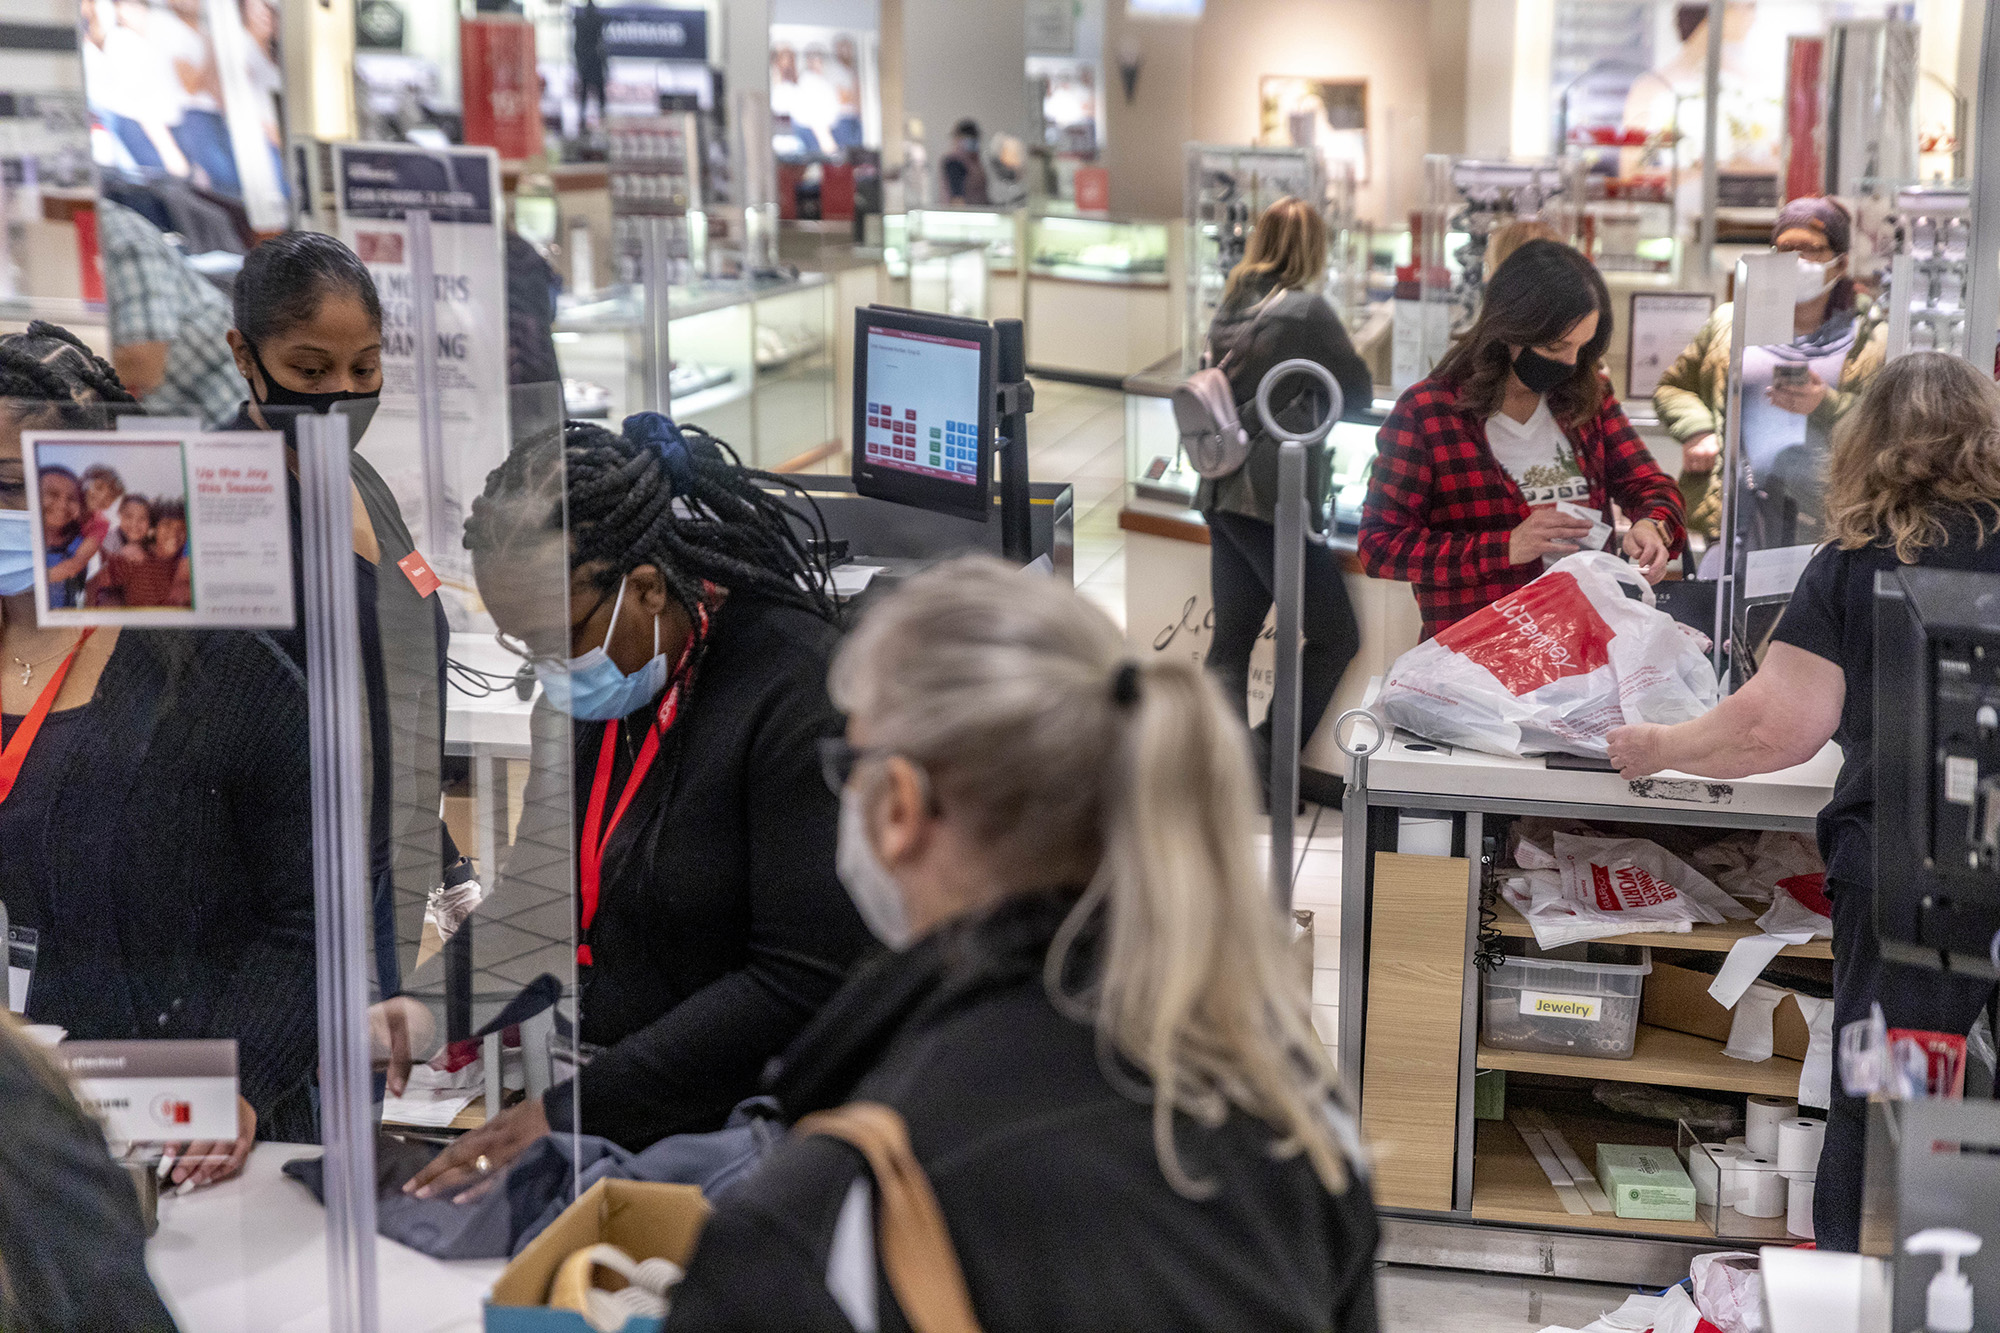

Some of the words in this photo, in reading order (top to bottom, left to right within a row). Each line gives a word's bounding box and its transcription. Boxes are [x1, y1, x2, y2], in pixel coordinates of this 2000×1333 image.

[1492, 599, 1578, 668] JCPenney
[1615, 866, 1647, 908] WORTH
[1536, 1000, 1590, 1017] Jewelry
